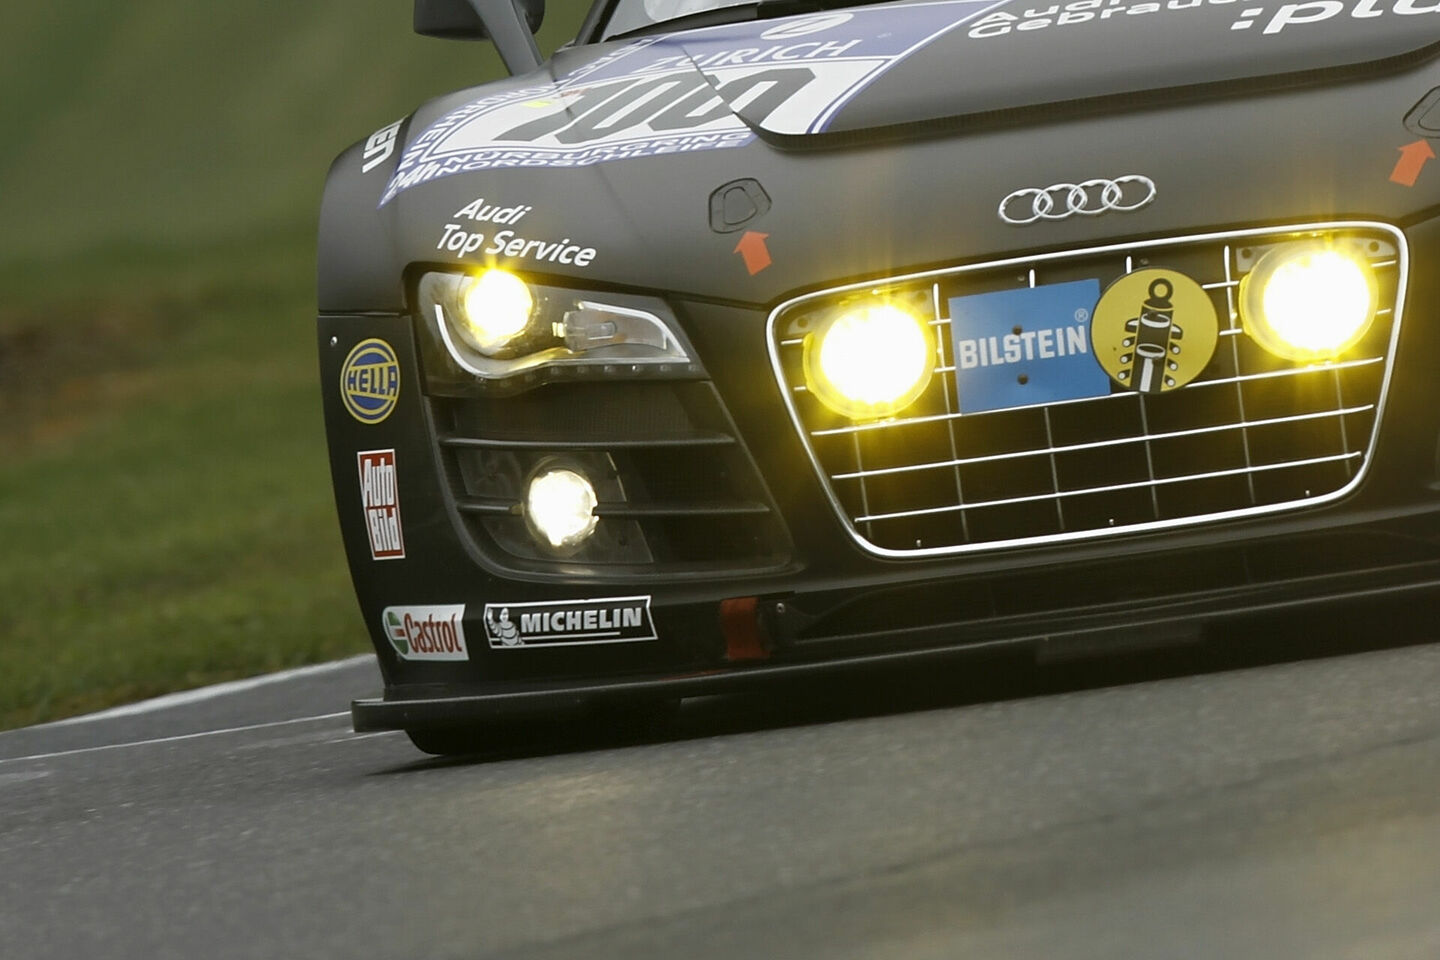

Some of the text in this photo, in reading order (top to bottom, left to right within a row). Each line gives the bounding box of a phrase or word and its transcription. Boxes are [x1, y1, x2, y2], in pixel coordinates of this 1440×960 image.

[633, 39, 863, 74] ZURICH
[453, 198, 532, 225] Audi
[436, 224, 597, 268] Top Service
[959, 325, 1088, 369] BILSTEIN
[347, 365, 398, 396] HELLA
[404, 614, 461, 653] Castrol
[521, 607, 642, 633] MICHELIN
